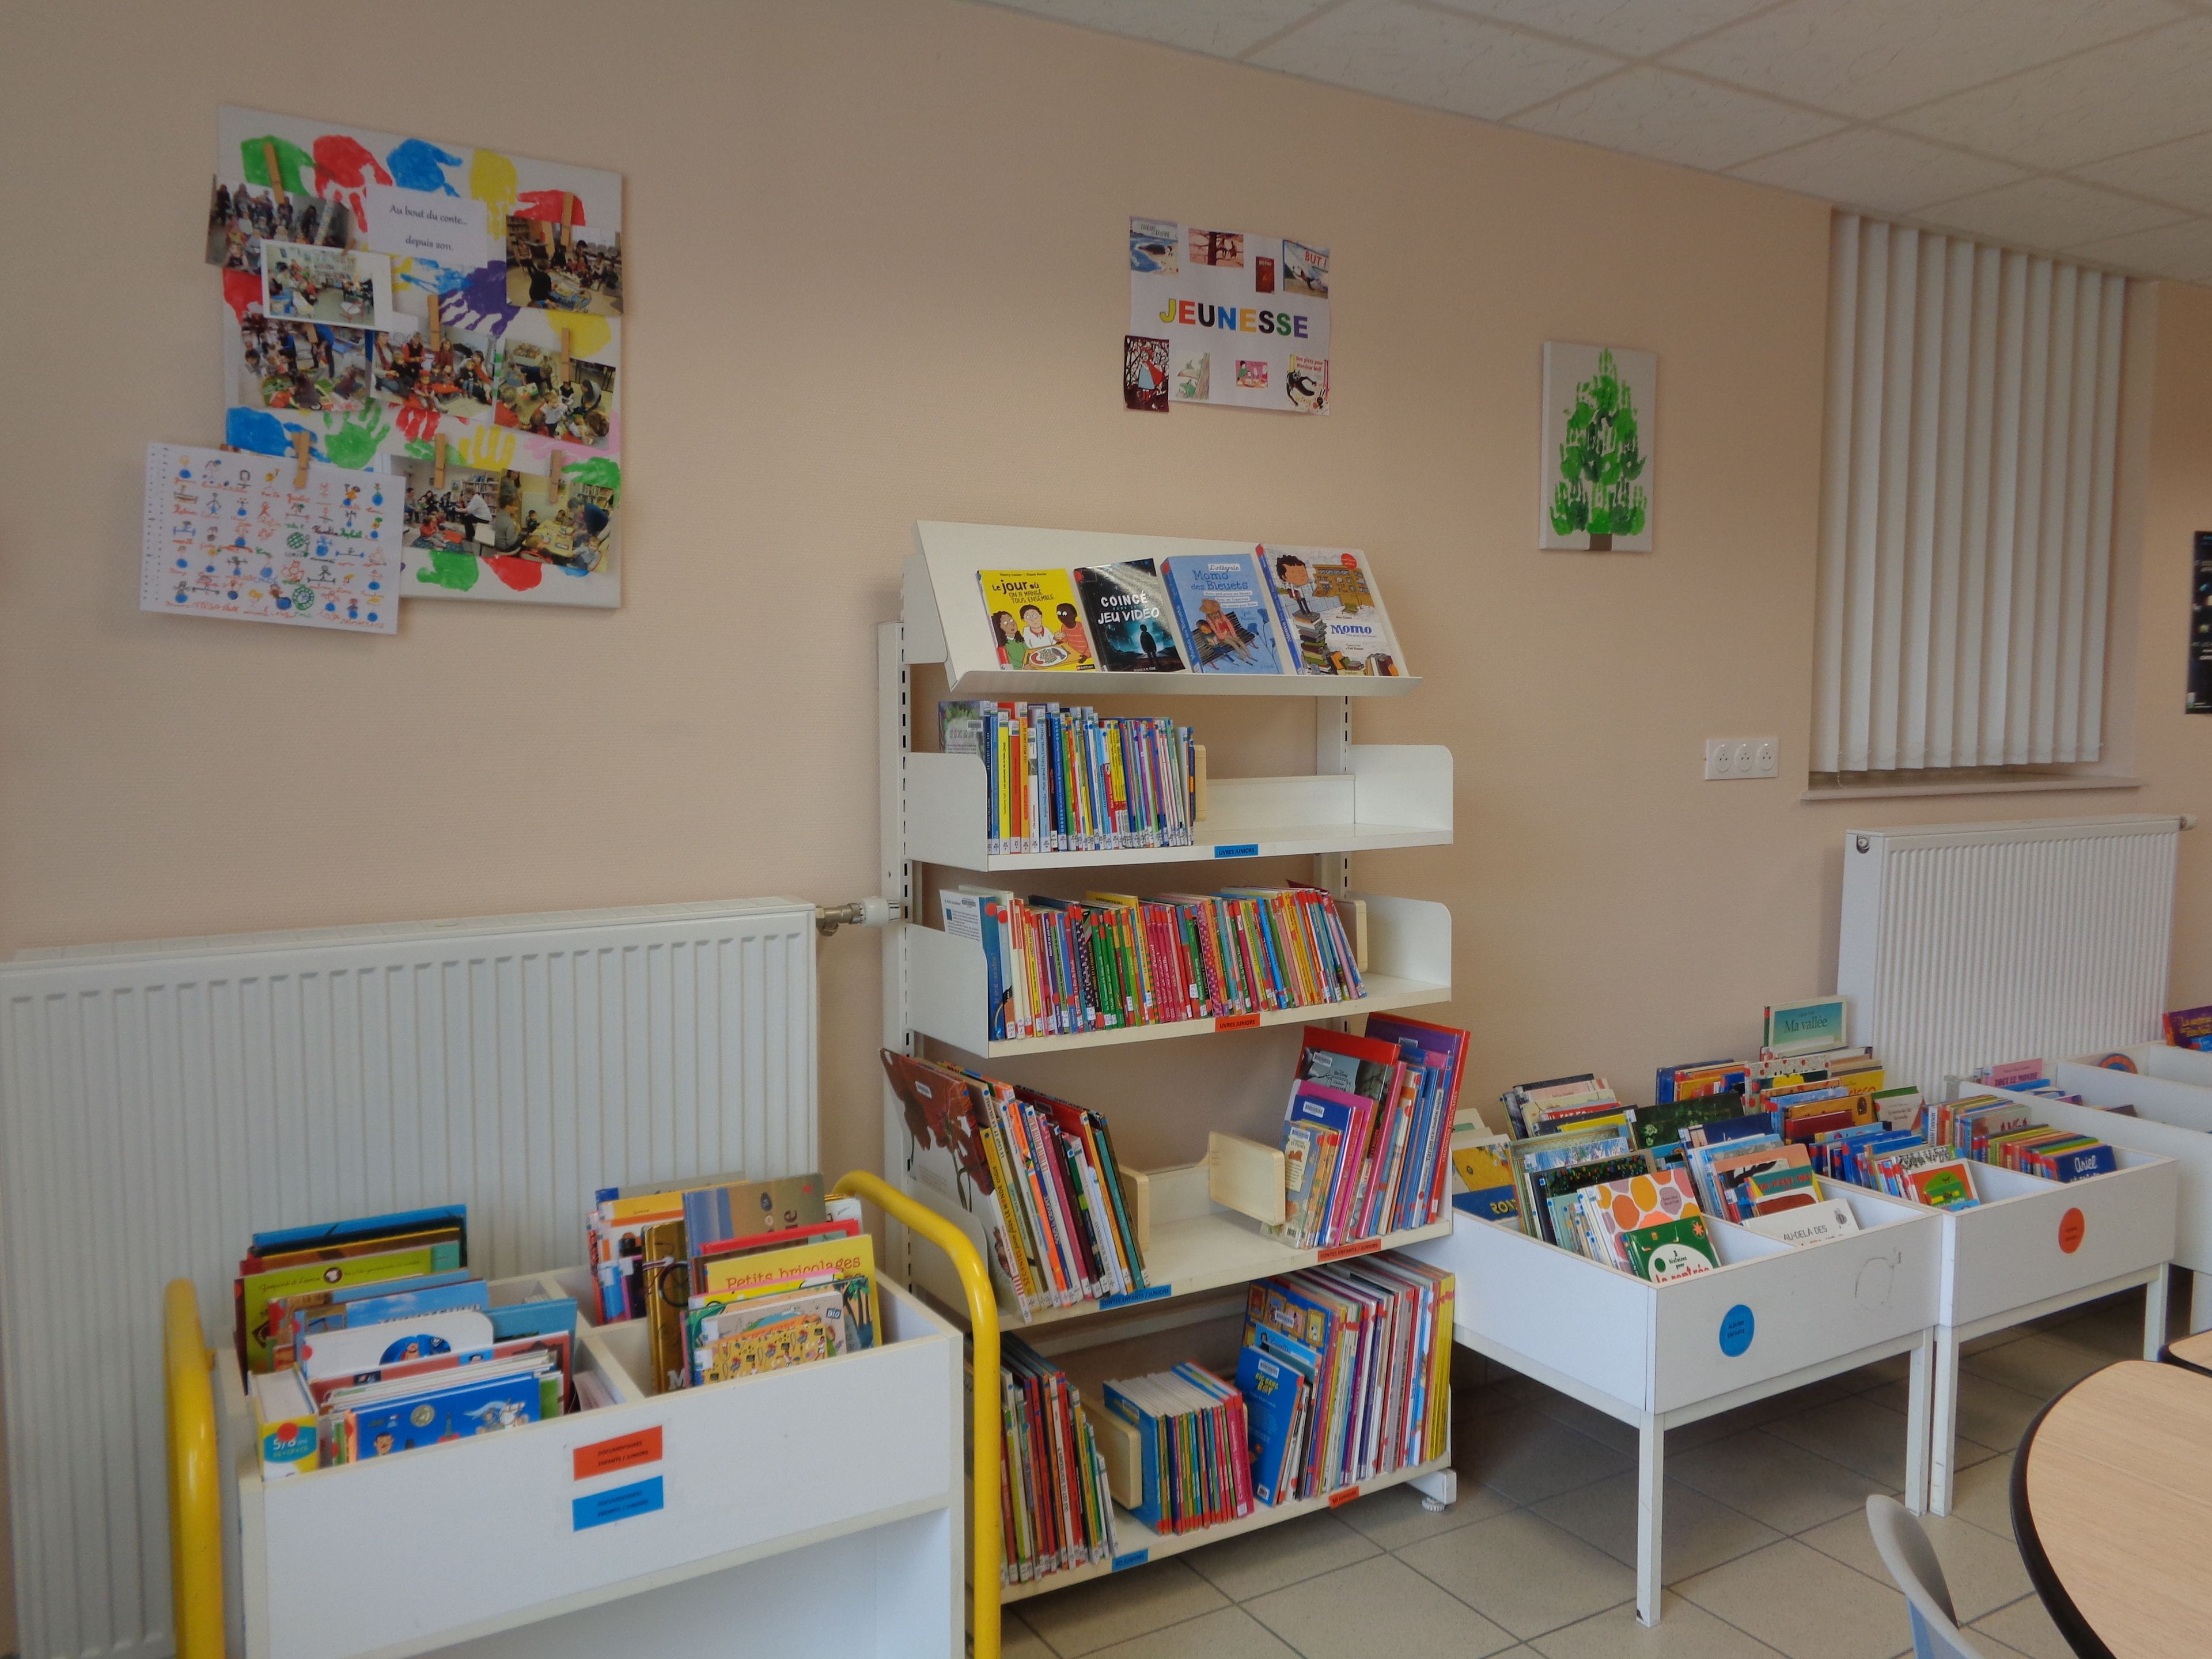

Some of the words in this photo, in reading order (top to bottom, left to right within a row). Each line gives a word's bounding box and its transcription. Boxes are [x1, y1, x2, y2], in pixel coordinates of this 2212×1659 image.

[389, 204, 403, 214] Au
[405, 206, 424, 218] bout
[426, 210, 438, 219] du
[406, 235, 433, 248] depuis
[1305, 251, 1322, 266] BUT
[1160, 298, 1308, 339] JEUNESSE
[1192, 570, 1229, 580] Momo
[1209, 565, 1240, 573] L'intégrale
[1001, 579, 1028, 594] jour
[1206, 581, 1249, 590] Bleuets
[1028, 594, 1055, 603] ENSEMBLE
[1101, 590, 1147, 607] COINCÉ
[1098, 612, 1121, 624] JEU
[1123, 605, 1160, 621] VIDÉO
[1330, 624, 1372, 635] Momo
[1783, 1020, 1798, 1033] Ma
[1801, 1015, 1828, 1030] vallée
[1995, 1078, 2009, 1086] TOUT
[2018, 1072, 2039, 1081] MONDE
[1441, 1129, 1451, 1162] CHANSONS
[1448, 1091, 1458, 1127] FRANÇAISES
[999, 1150, 1005, 1158] LE
[1425, 1141, 1434, 1162] Taram
[2074, 1154, 2097, 1173] Ariel
[998, 1184, 1009, 1209] MONDE
[1003, 1210, 1011, 1218] LE
[1053, 1229, 1061, 1245] SOUS
[1814, 1225, 1827, 1234] DES
[1338, 1247, 1357, 1255] ENFANTS
[725, 1272, 773, 1289] Petits
[778, 1256, 861, 1279] bricolages
[1022, 1275, 1031, 1286] 52
[1148, 1288, 1169, 1297] JUNIORS
[827, 1308, 841, 1318] BIO
[597, 1441, 642, 1456] DOCUMENTAIRES
[598, 1456, 622, 1466] ENFANTS
[626, 1450, 649, 1460] JUNIORS
[597, 1491, 642, 1507] DOCUMENTAIRES
[598, 1506, 622, 1517] ENFANTS
[626, 1499, 649, 1510] JUNIORS
